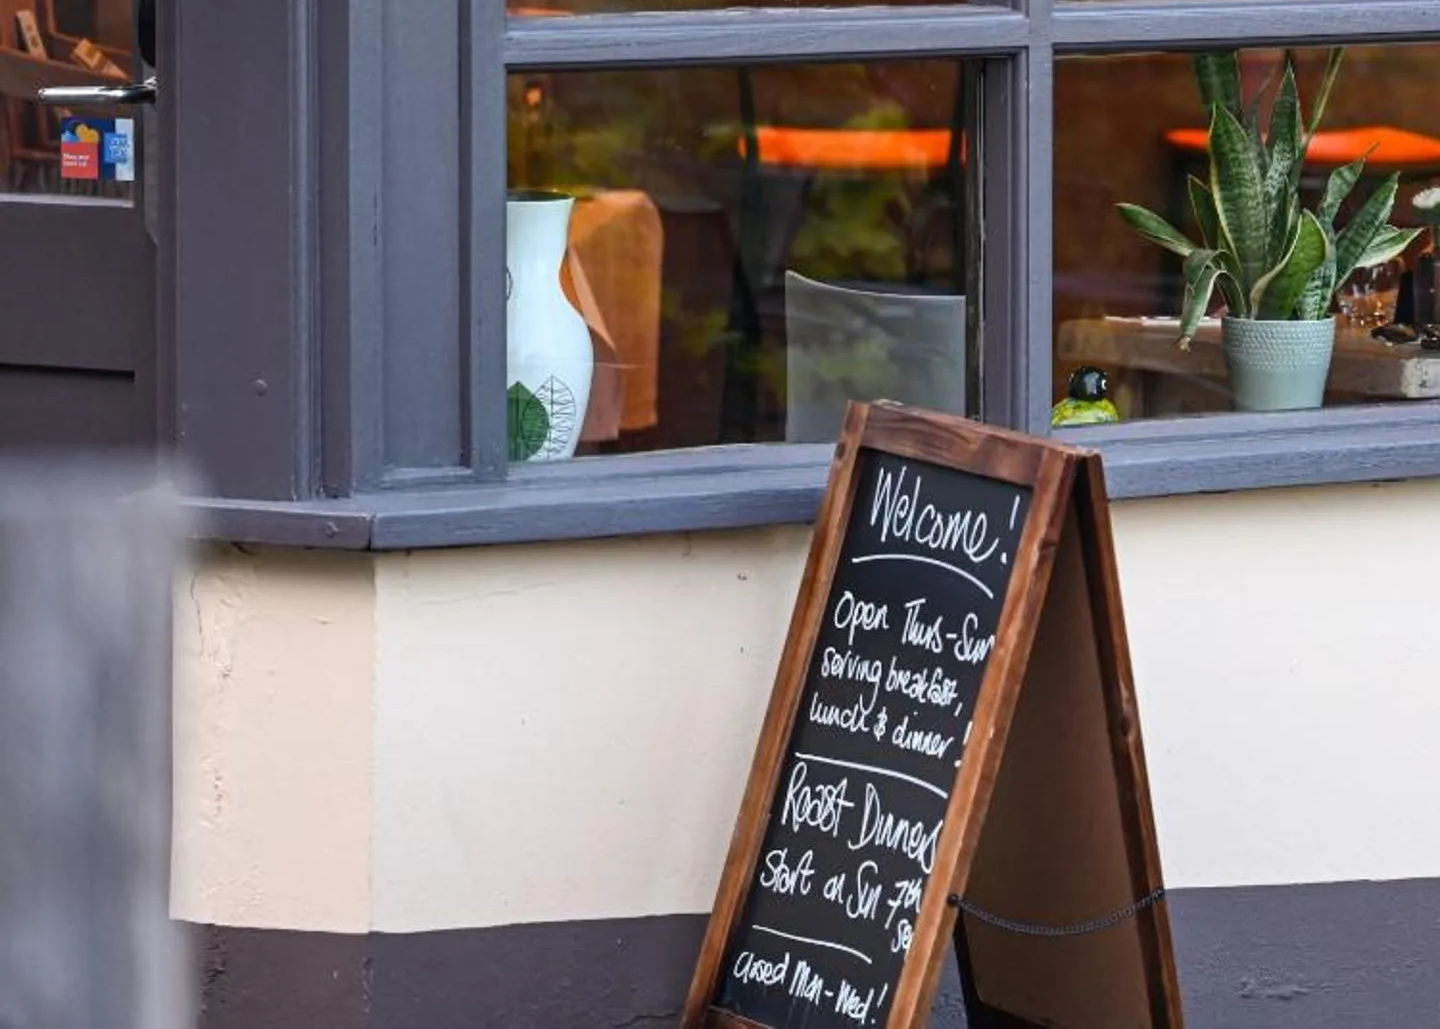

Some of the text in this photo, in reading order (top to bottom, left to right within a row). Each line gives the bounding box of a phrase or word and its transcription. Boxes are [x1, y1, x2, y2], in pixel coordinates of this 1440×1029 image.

[834, 590, 889, 645] Open
[781, 761, 854, 837] Roast
[823, 873, 844, 904] on
[846, 860, 882, 920] Sun
